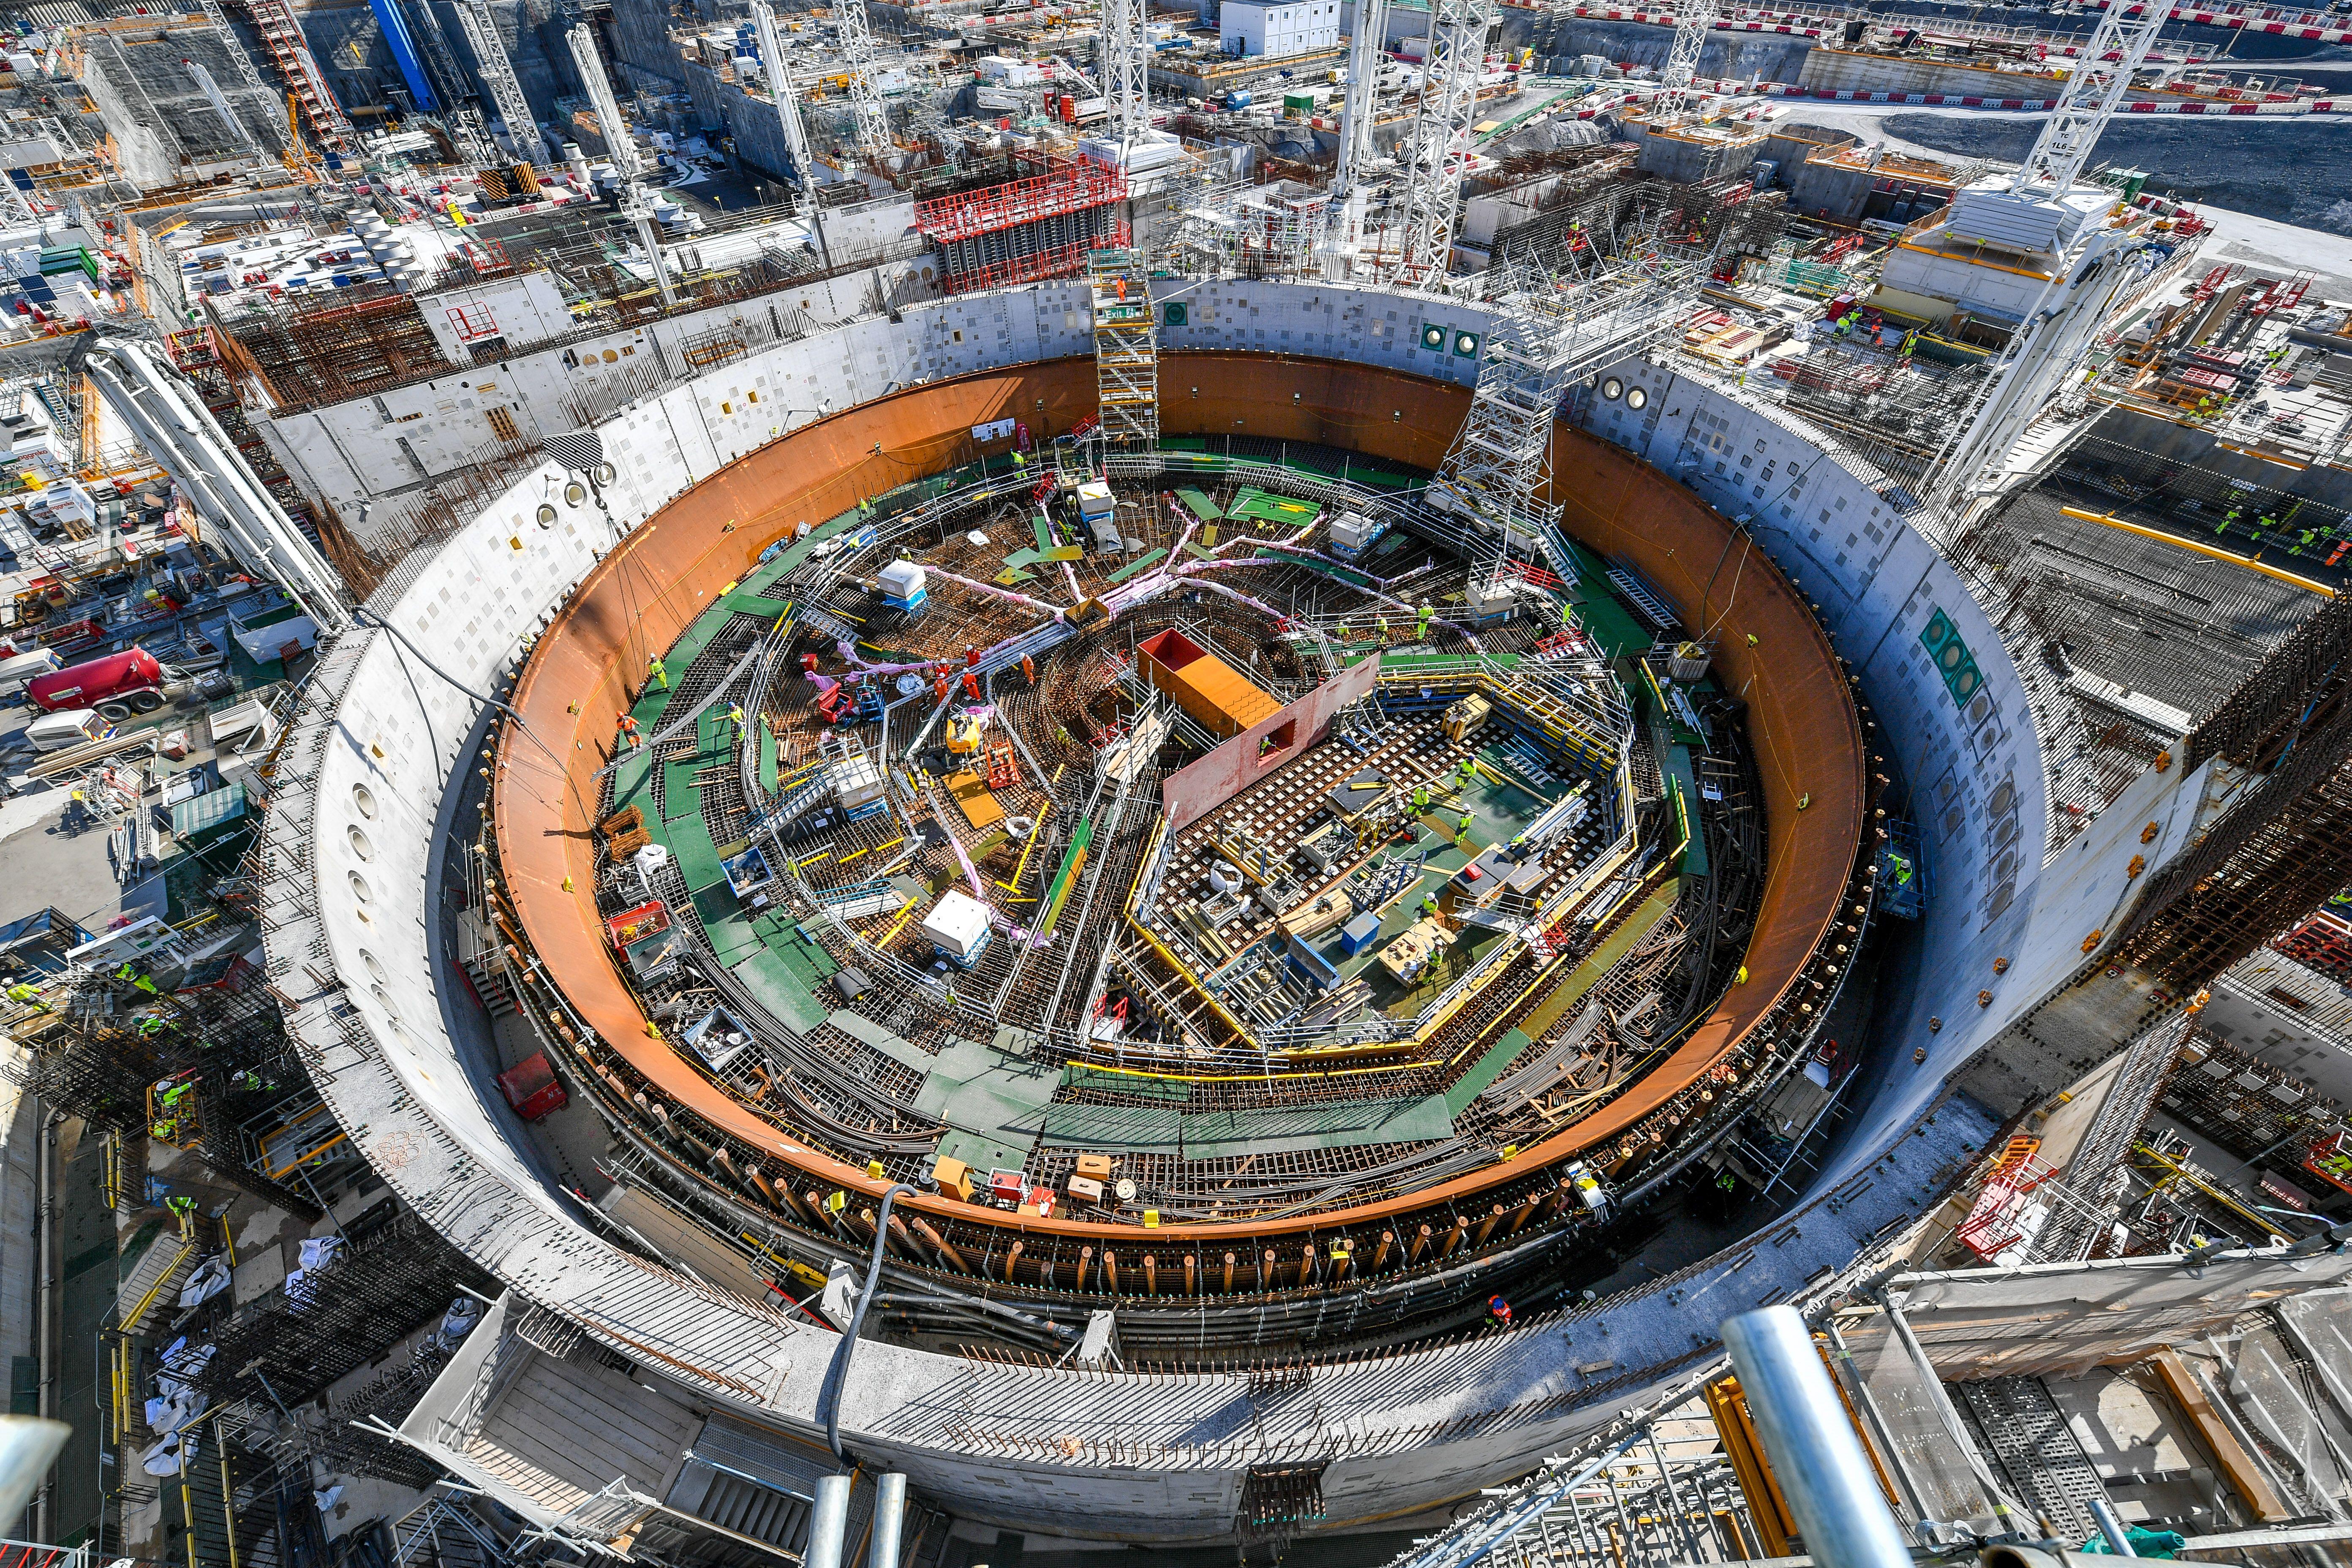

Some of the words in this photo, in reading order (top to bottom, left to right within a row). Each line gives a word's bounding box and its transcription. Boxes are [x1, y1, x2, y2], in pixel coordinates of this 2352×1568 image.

[1106, 310, 1122, 318] Exit
[18, 450, 48, 460] aggreko
[50, 501, 74, 510] aggreko
